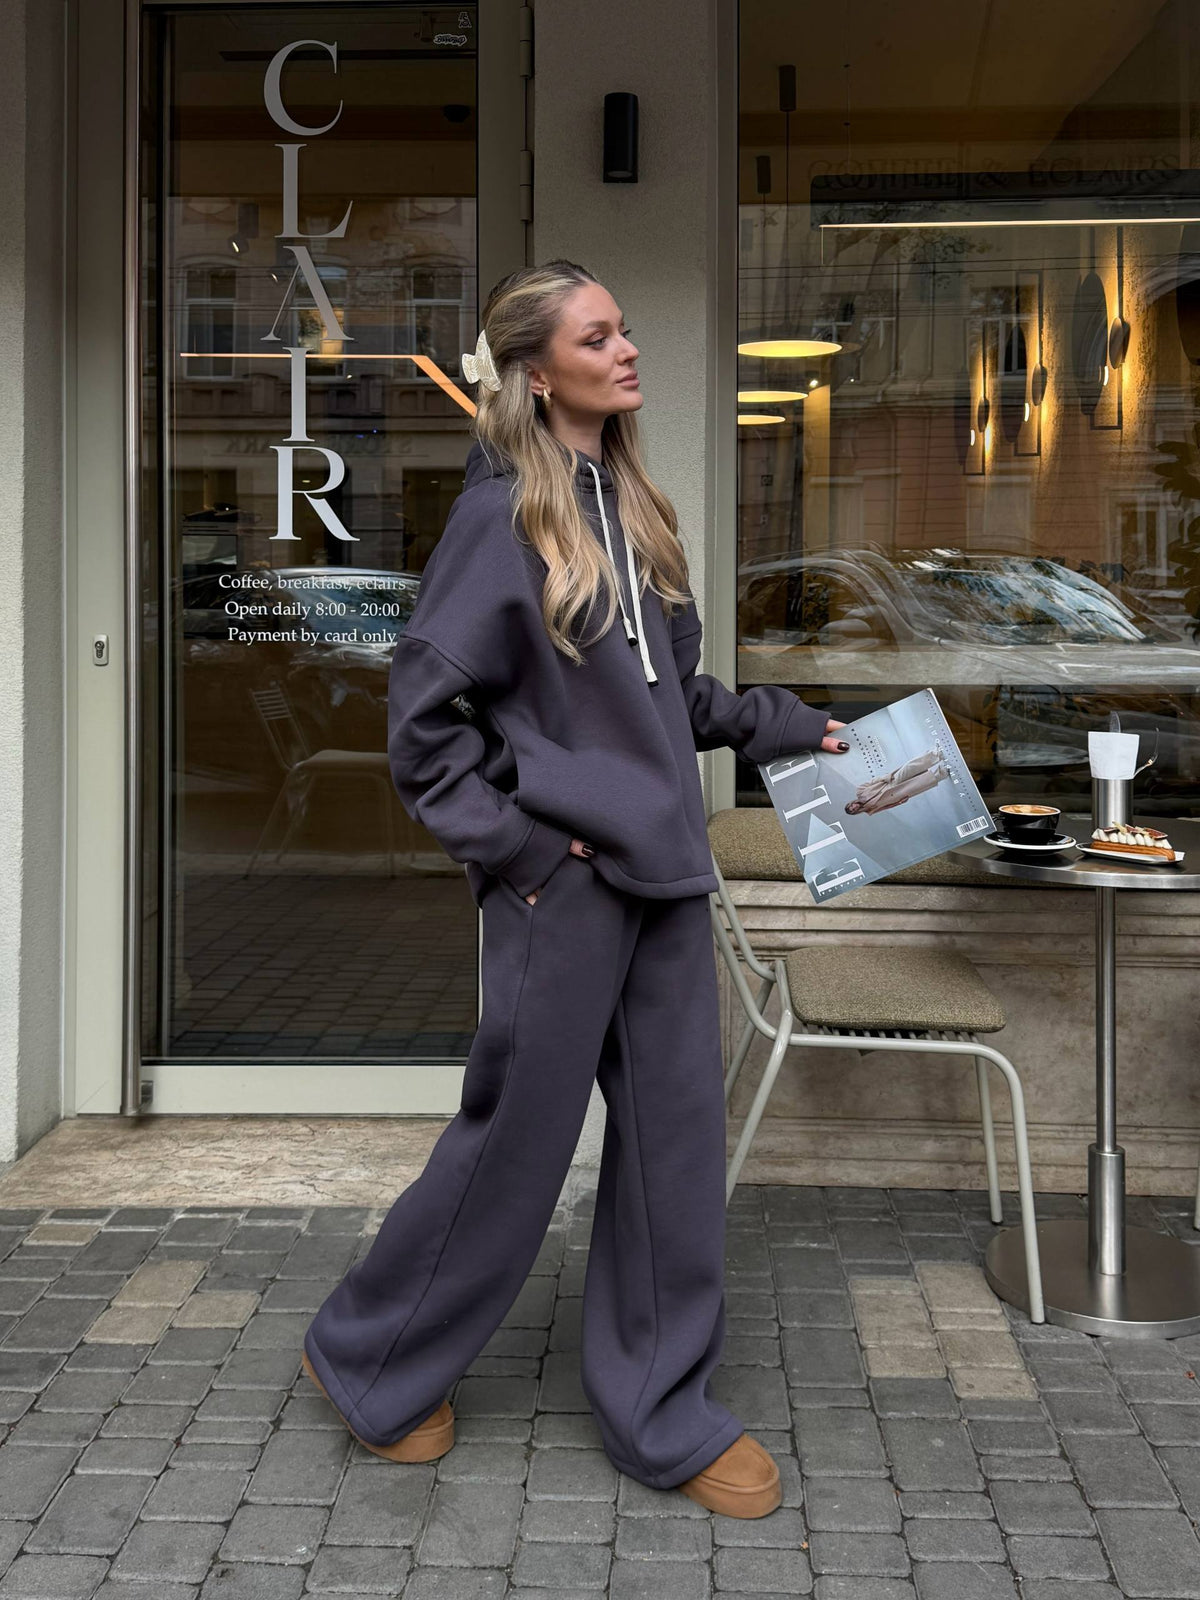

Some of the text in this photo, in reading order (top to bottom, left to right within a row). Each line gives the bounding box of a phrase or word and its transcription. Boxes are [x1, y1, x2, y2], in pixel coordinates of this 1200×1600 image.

[261, 39, 361, 542] CLAIR
[218, 575, 406, 591] Coffee, breakfast, eclairs
[224, 601, 268, 619] Open
[272, 602, 311, 620] daily
[315, 603, 346, 616] 8:00
[360, 603, 400, 616] 20:00
[228, 628, 397, 646] Payment by card only
[765, 750, 866, 896] ELLE
